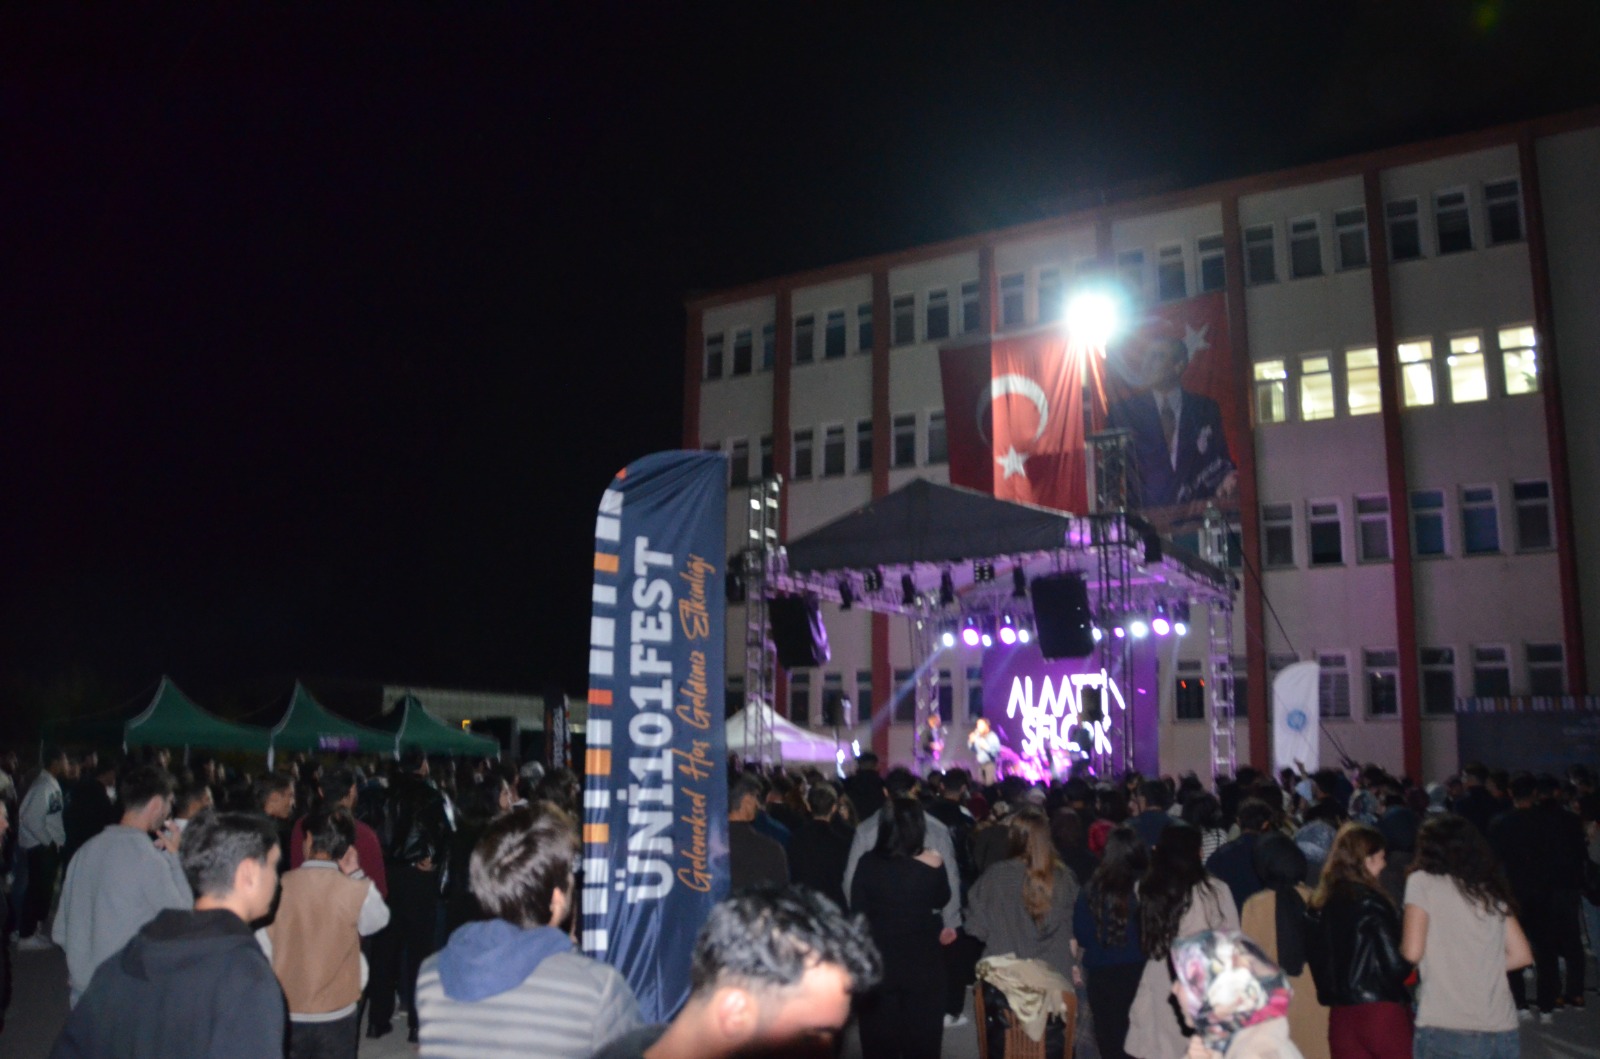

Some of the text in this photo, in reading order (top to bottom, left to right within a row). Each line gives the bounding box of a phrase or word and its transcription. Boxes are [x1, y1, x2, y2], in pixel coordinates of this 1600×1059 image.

[615, 535, 674, 904] ÜNİ101FEST
[673, 553, 716, 892] Geleneksel Hoş Geldiniz Etkinliği
